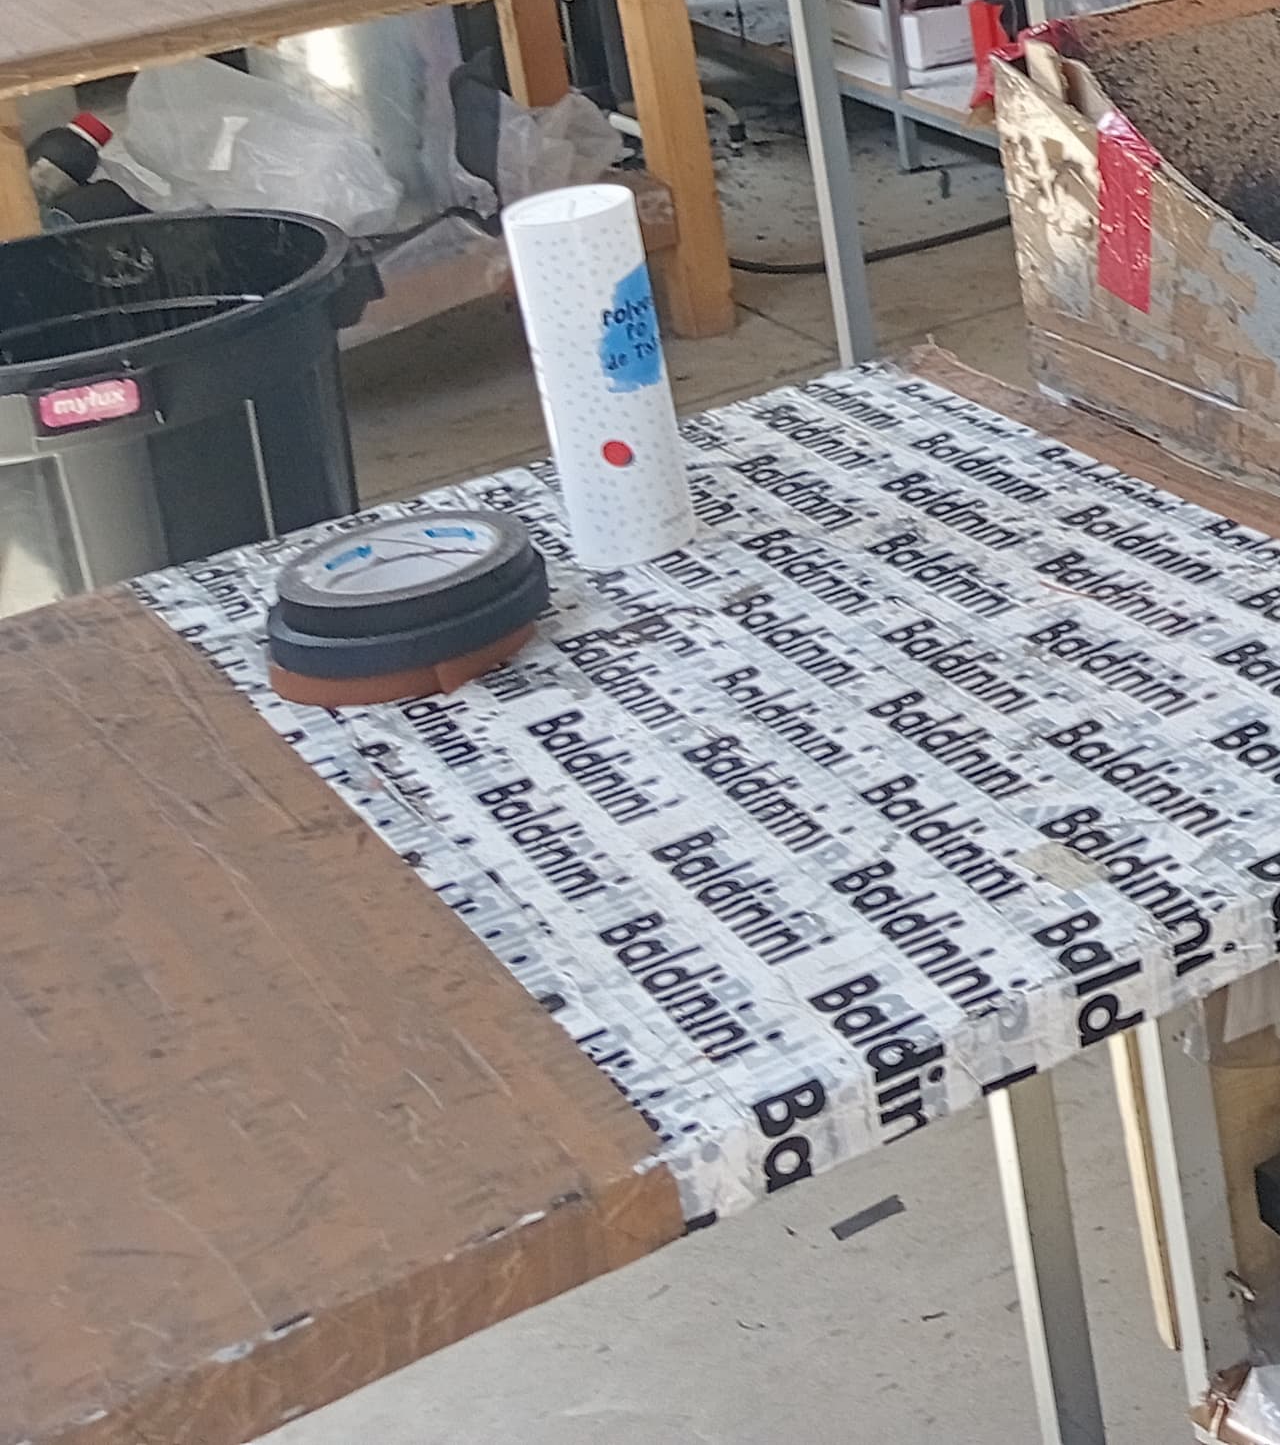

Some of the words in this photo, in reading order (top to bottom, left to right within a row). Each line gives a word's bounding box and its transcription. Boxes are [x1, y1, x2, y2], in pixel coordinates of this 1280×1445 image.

[733, 454, 879, 534] Baldinini
[881, 471, 1042, 551] Baldinini
[909, 431, 1067, 503] Baldinini
[741, 528, 898, 616] Baldinini
[866, 531, 1036, 619] Baldinini
[1034, 551, 1217, 637] Baldinini
[1058, 504, 1241, 584] Baldinini
[554, 628, 706, 730] Baldinini
[721, 593, 888, 688] Baldinini
[882, 618, 1058, 714] Baldinini
[1026, 619, 1218, 717] Baldinini
[526, 709, 687, 825] Baldinini
[712, 666, 881, 768] Baldinini
[867, 691, 1055, 800] Baldinini
[681, 734, 856, 853] Baldinini
[1046, 719, 1253, 837] Baldinini
[478, 778, 630, 901] Baldinini
[861, 774, 1045, 902] Baldinini
[652, 830, 836, 966] Baldinini
[830, 860, 1028, 1012] Baldinini
[1039, 806, 1236, 977] Baldinini
[600, 911, 782, 1061] Baldinini
